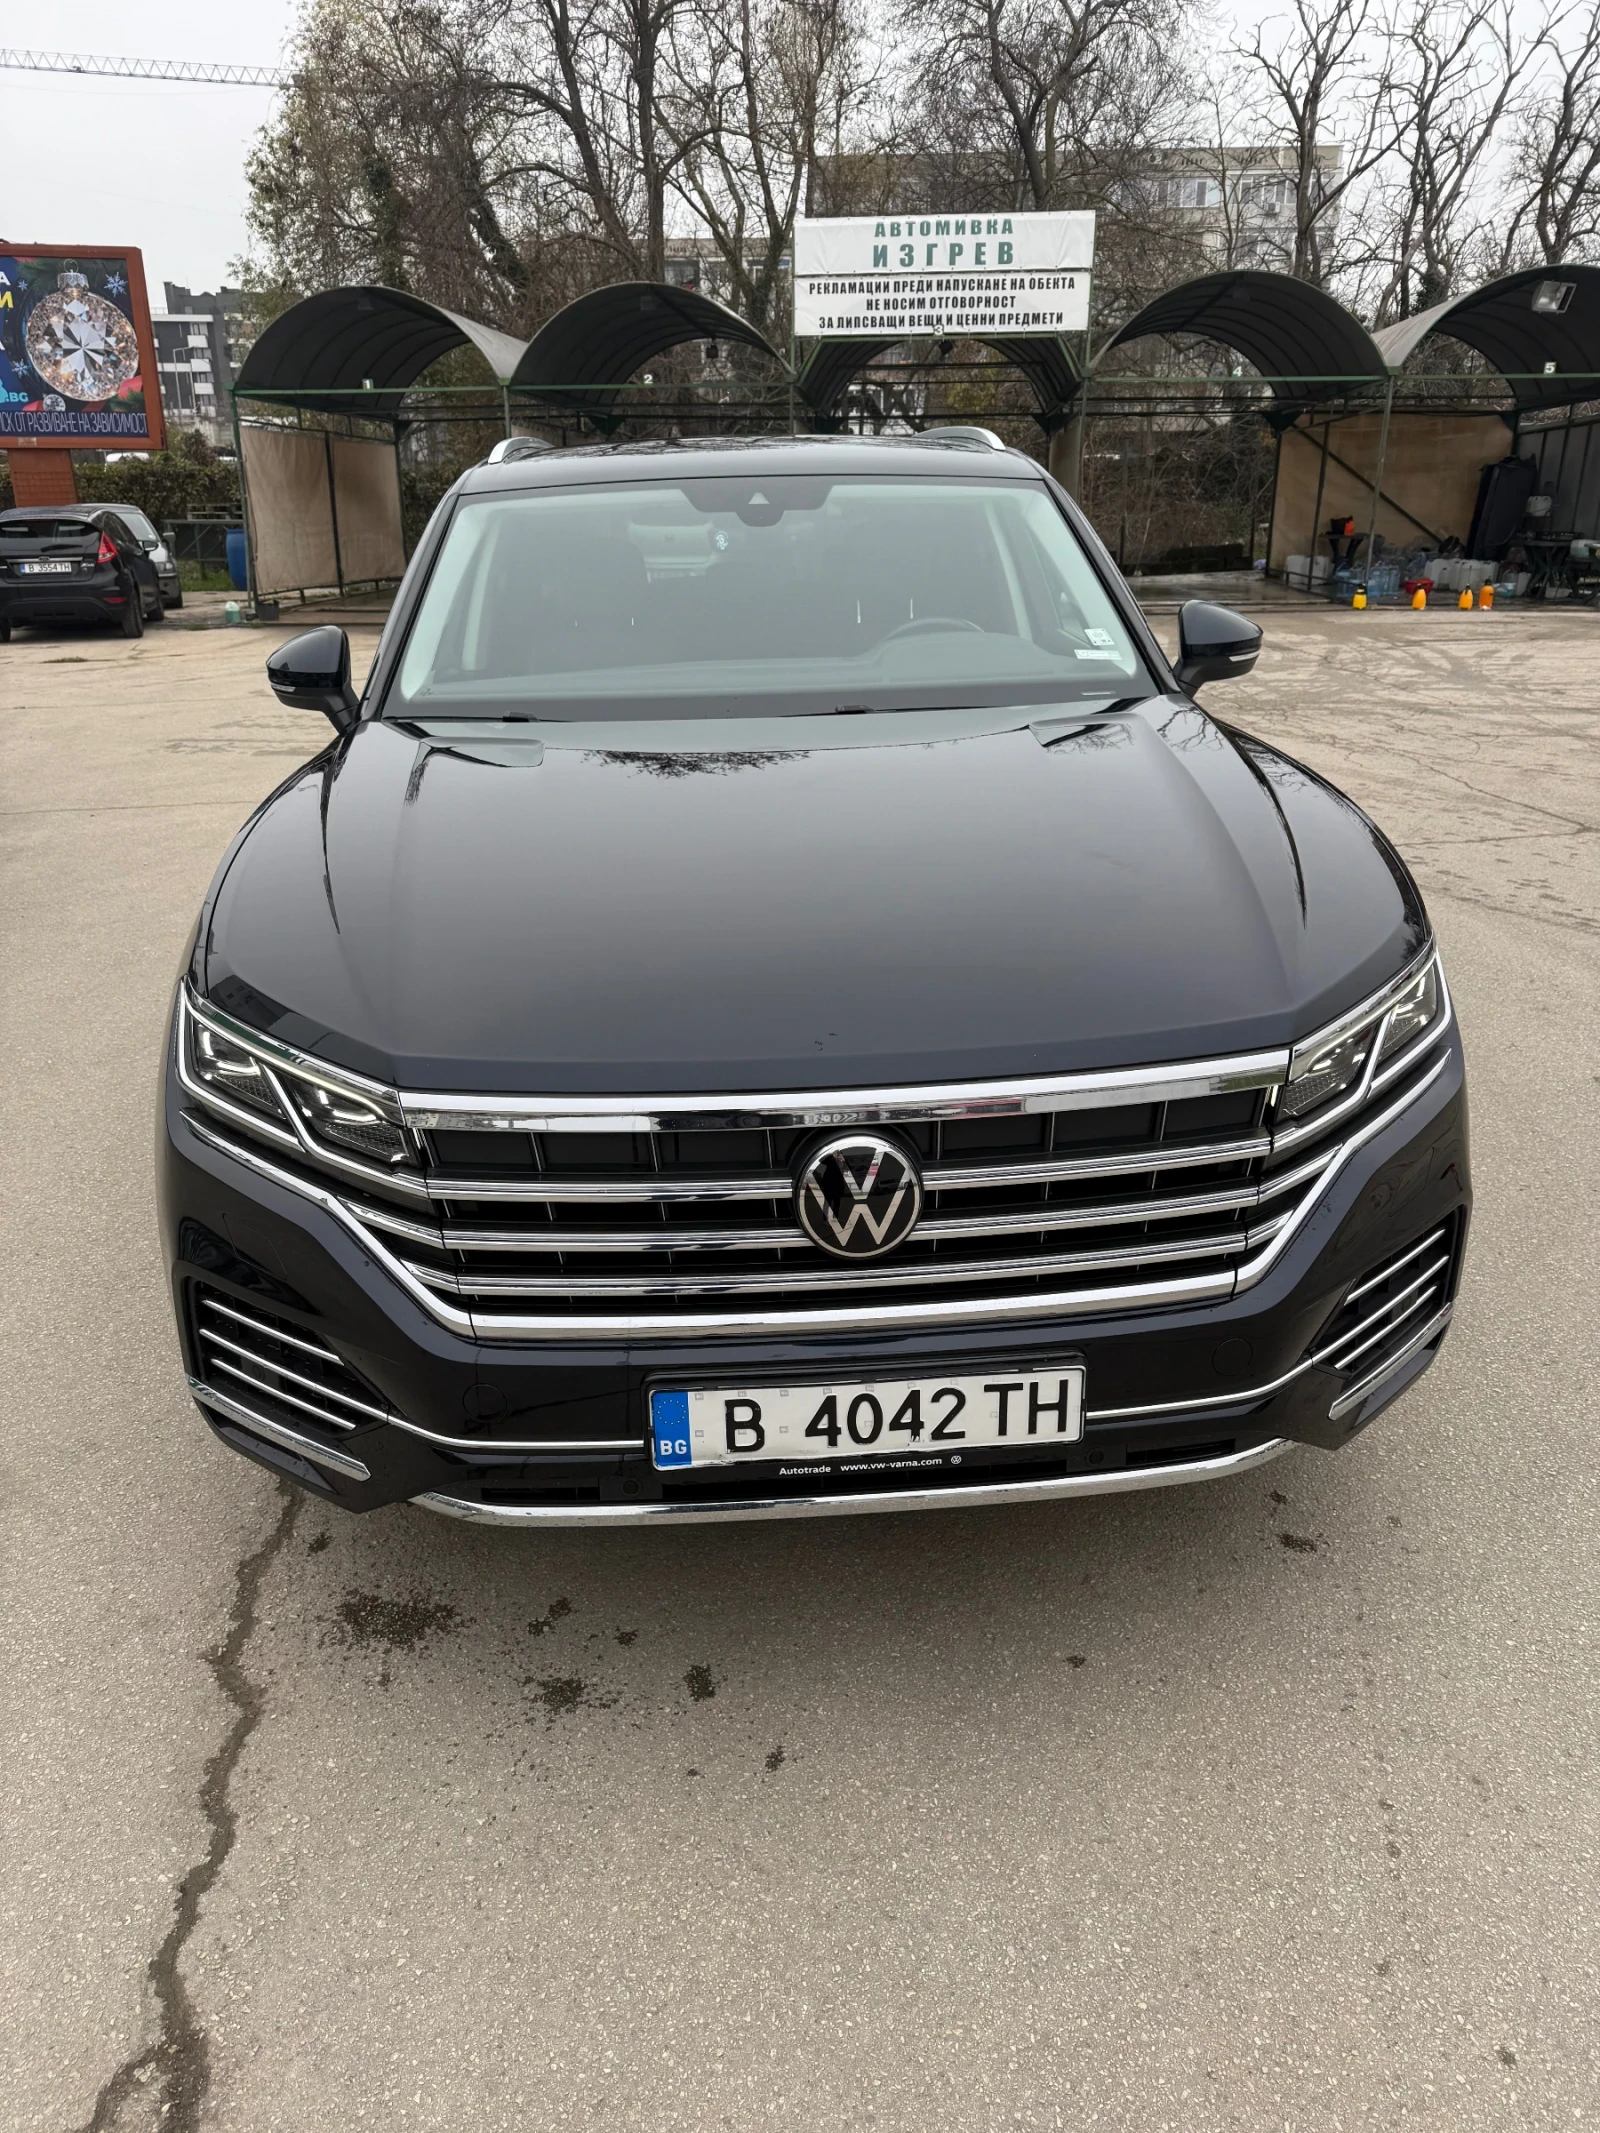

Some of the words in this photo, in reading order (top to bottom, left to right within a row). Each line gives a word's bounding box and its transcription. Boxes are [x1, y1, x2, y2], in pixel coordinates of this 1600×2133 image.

[874, 218, 1014, 238] АВТОМИВКА
[873, 241, 1014, 268] ИЗГРЕВ
[809, 281, 890, 295] РЕКЛАМАЦИИ
[893, 280, 933, 294] ПРЕДИ
[936, 278, 1007, 292] НАПУСКАНЕ
[1010, 278, 1026, 291] НА
[1029, 277, 1075, 290] ОБЕКТА
[866, 298, 881, 311] НЕ
[884, 297, 926, 310] НОСИМ
[929, 295, 1016, 309] ОТГОВОРНОСТ
[819, 316, 834, 328] ЗА
[837, 315, 905, 329] ЛИПСВАЩИ
[908, 314, 943, 327] ВЕЩИ
[946, 314, 953, 326] И
[956, 313, 995, 327] ЦЕННИ
[999, 312, 1063, 327] ПРЕДМЕТИ
[934, 325, 944, 336] 3
[1233, 366, 1243, 377] 4
[1545, 362, 1556, 374] 5
[363, 379, 371, 390] 1
[643, 374, 653, 385] 2
[15, 411, 26, 432] ОТ
[27, 411, 78, 433] РАЗВИВАНЕ
[77, 412, 91, 433] НА
[90, 412, 147, 433] ЗАВИСИМОСТ
[725, 1399, 765, 1454] B
[804, 1387, 967, 1448] 4042
[983, 1379, 1069, 1437] TH
[660, 1440, 687, 1456] BG
[778, 1465, 832, 1476] Autotrade
[840, 1457, 943, 1472] www.vw-varna.com
